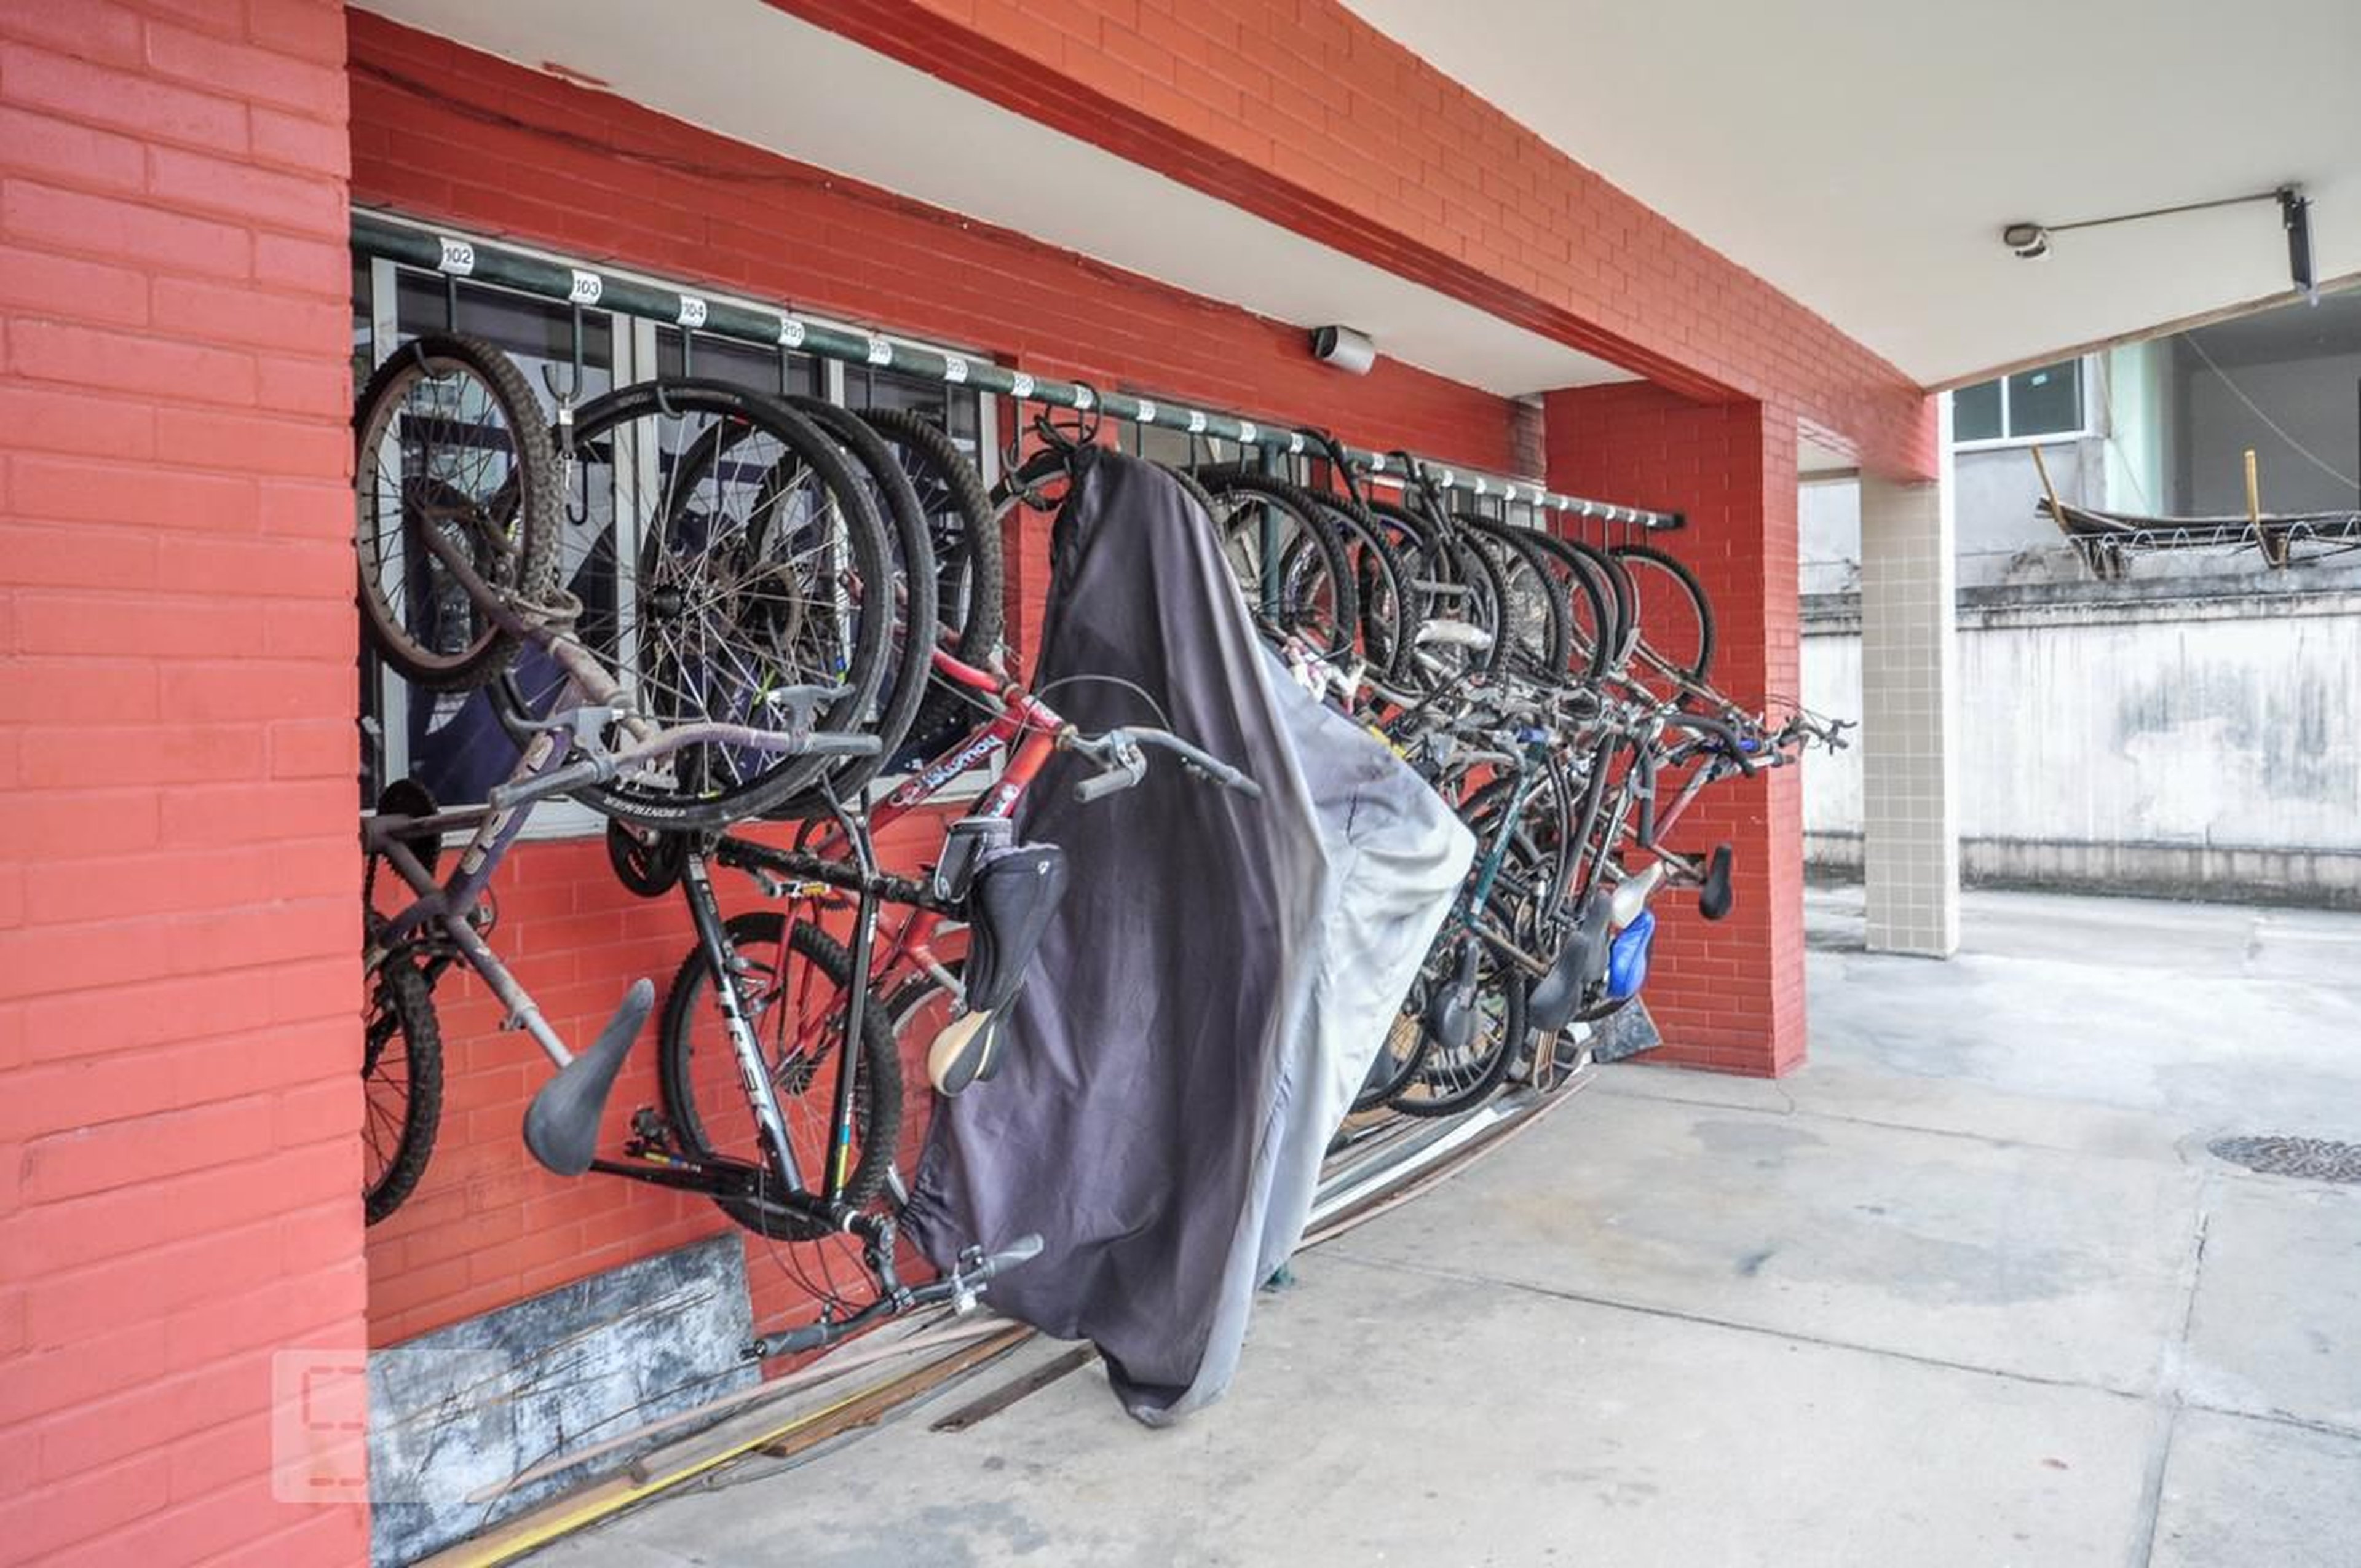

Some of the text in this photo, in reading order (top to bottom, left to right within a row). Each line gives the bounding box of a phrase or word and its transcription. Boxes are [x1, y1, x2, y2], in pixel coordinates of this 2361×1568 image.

[443, 246, 472, 265] 102
[576, 278, 600, 296] 103
[684, 302, 704, 318] 104
[718, 976, 778, 1131] TREK
